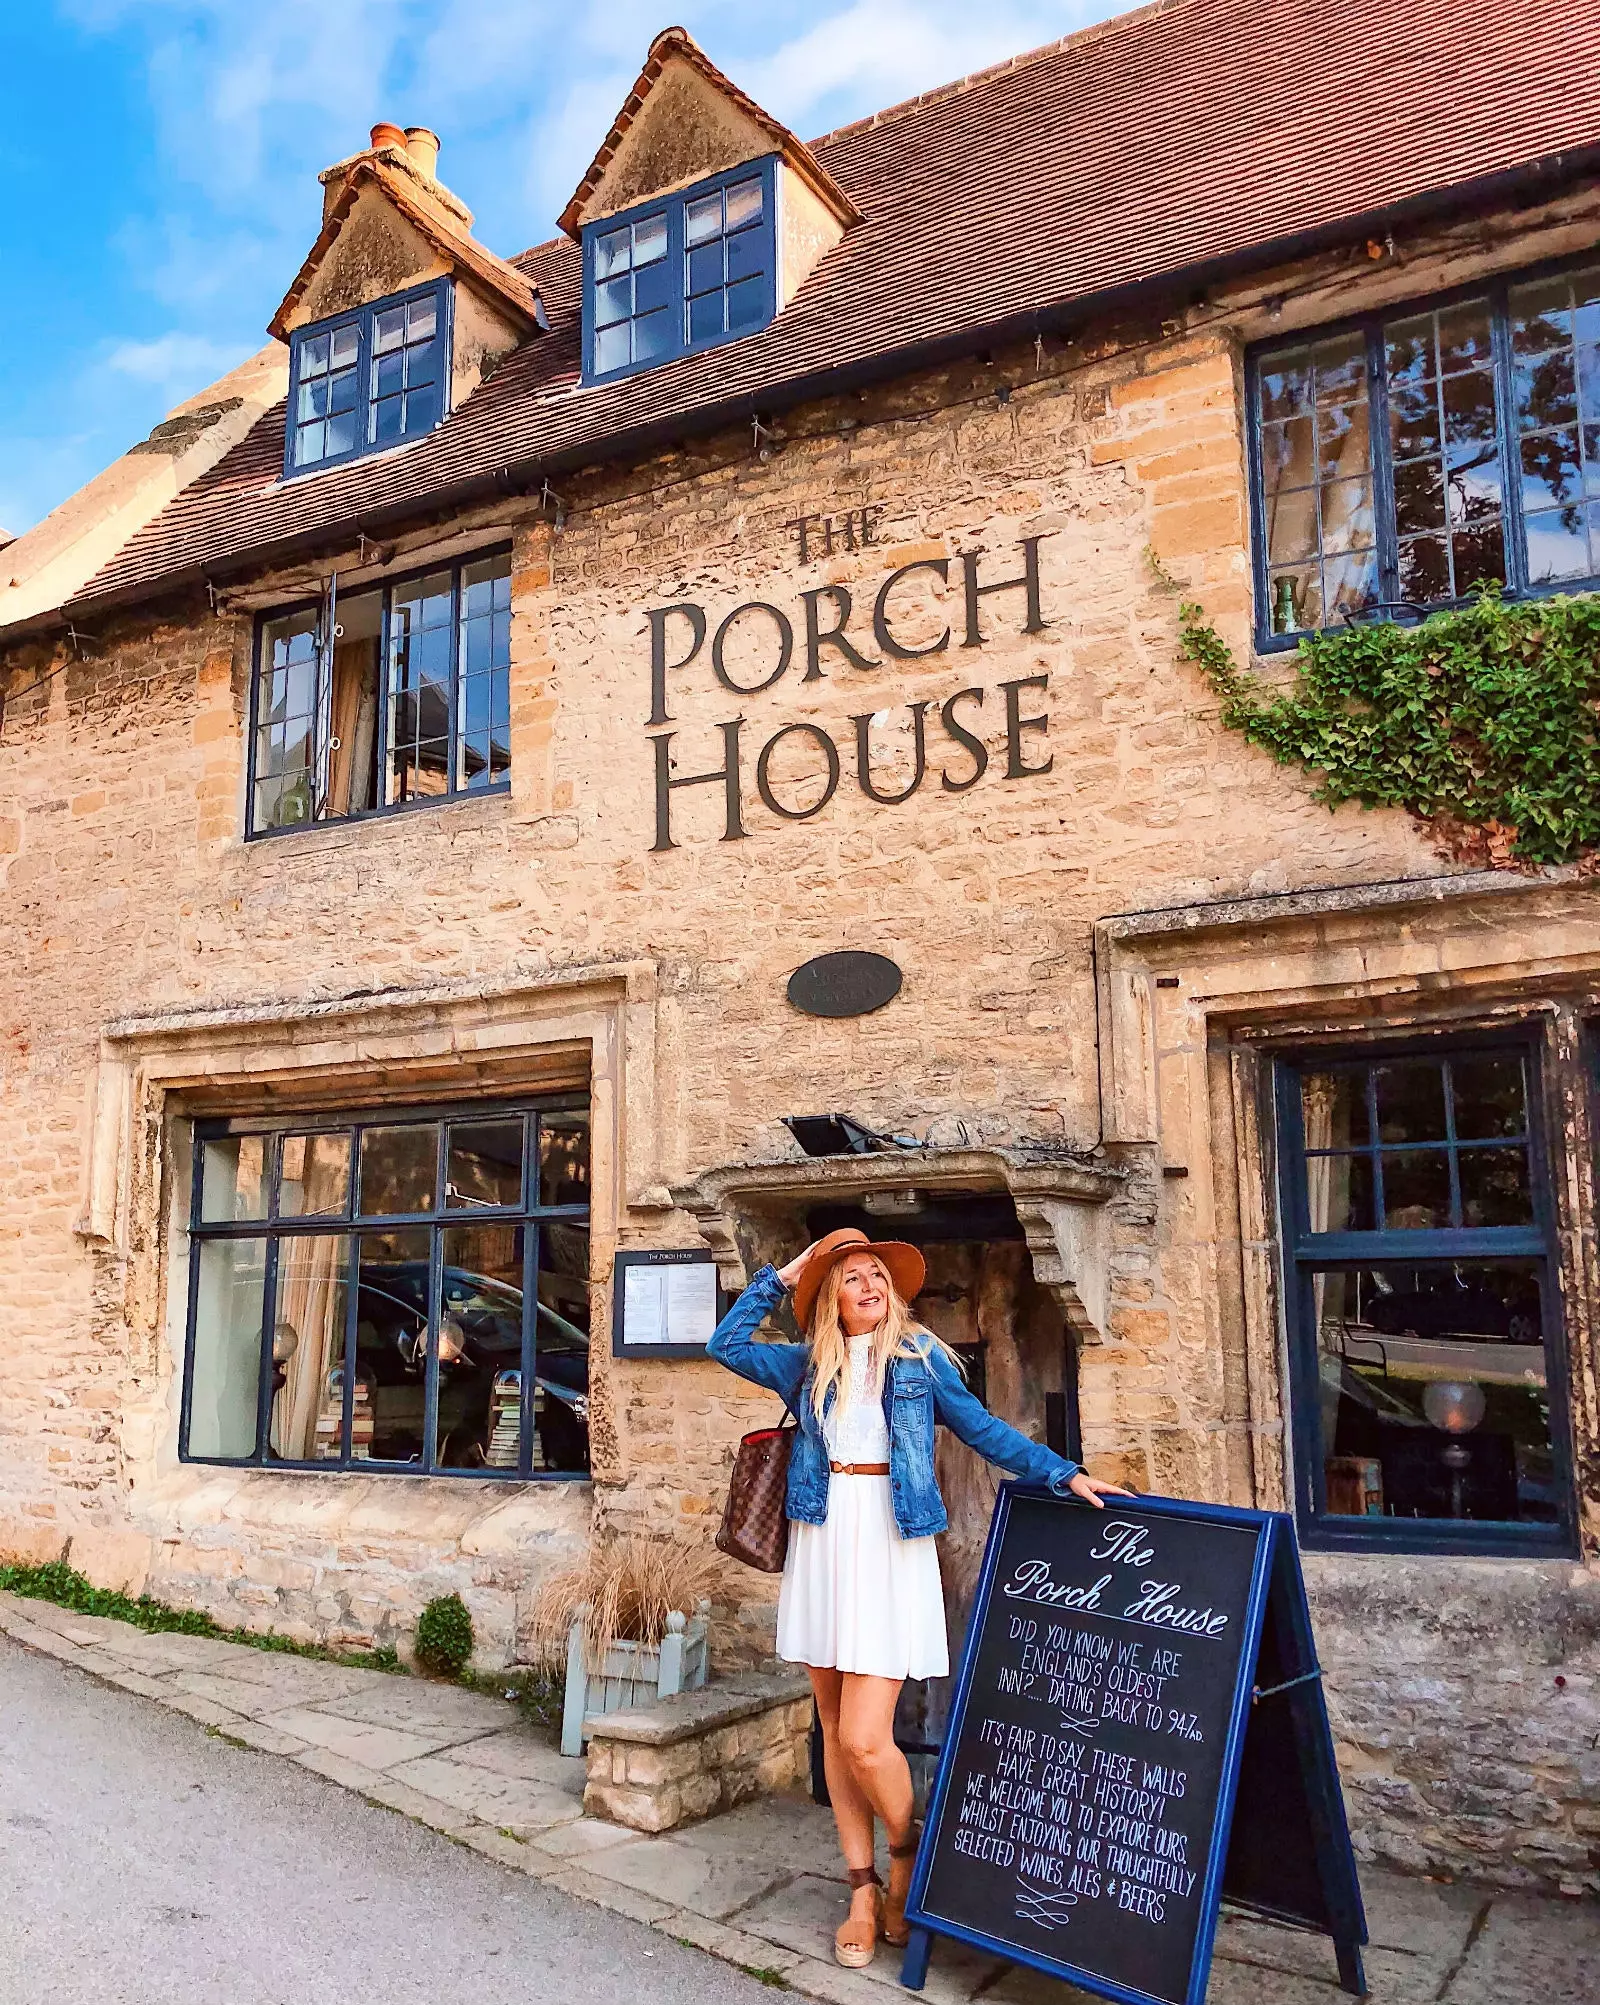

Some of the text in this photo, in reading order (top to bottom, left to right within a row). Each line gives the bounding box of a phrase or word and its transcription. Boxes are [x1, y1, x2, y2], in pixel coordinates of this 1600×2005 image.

[788, 506, 882, 566] THE
[643, 531, 1060, 727] PORCH
[645, 674, 1054, 852] HOUSE
[1090, 1521, 1155, 1567] The
[1003, 1560, 1230, 1636] Porch House
[1021, 1644, 1168, 1701] ENGLAND'S OLDEST
[1045, 1624, 1072, 1652] YOU
[1073, 1629, 1114, 1661] KNOW
[1118, 1640, 1144, 1669] WE
[1150, 1648, 1183, 1678] ARE
[1047, 1678, 1096, 1714] DATING
[1101, 1692, 1142, 1726] BACK
[1145, 1702, 1163, 1731] TO
[980, 1718, 1005, 1747] IT'S
[1006, 1725, 1036, 1759] FAIR
[1039, 1733, 1056, 1761] TO
[1092, 1749, 1137, 1785] THESE
[1142, 1761, 1187, 1798] WALLS
[996, 1749, 1166, 1823] HAVE GREAT HISTORY!
[959, 1797, 1197, 1898] WHILST ENJOYING OUR THOUGHTFULLY
[966, 1771, 987, 1799] WE
[989, 1776, 1047, 1819] WELCOME
[1049, 1795, 1073, 1826] YOU
[1077, 1804, 1094, 1832] TO
[1097, 1810, 1154, 1852] EXPLORE
[954, 1829, 1016, 1867] SELECTED
[1020, 1847, 1064, 1889] WINES,
[1067, 1864, 1102, 1899] ALES
[1118, 1880, 1167, 1924] BEERS.
